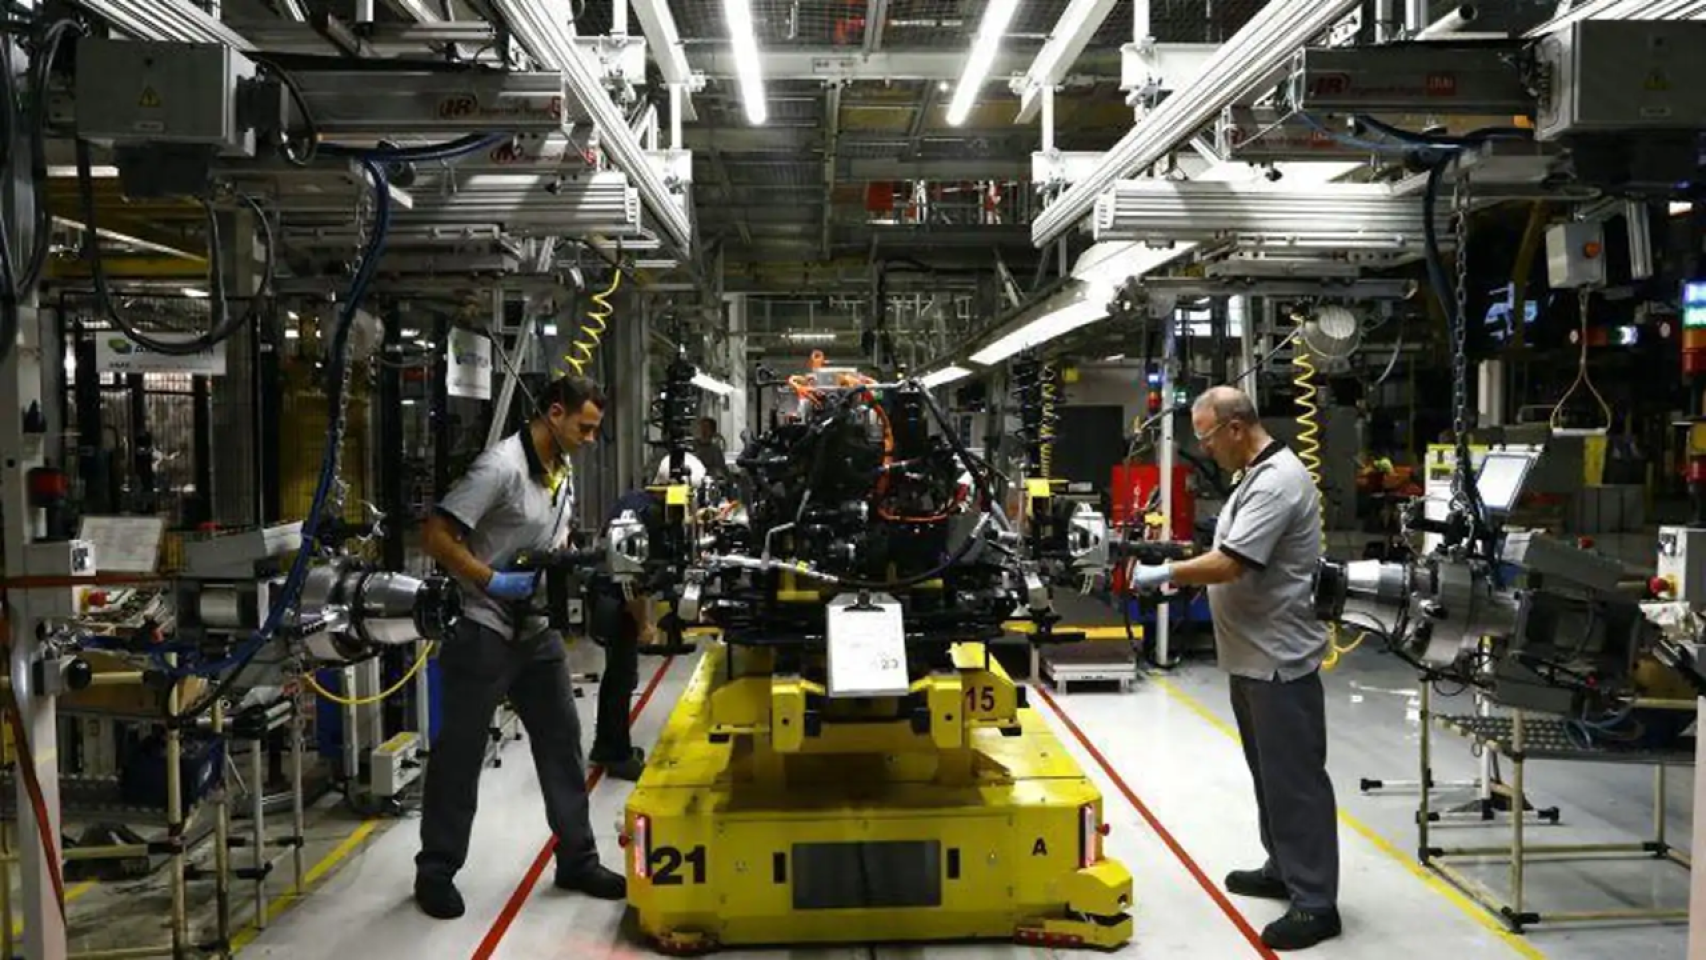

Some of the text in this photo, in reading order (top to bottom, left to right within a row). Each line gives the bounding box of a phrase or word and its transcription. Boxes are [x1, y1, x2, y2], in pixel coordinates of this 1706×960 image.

[965, 686, 995, 712] 15
[1032, 838, 1048, 857] A
[651, 845, 706, 885] 21
